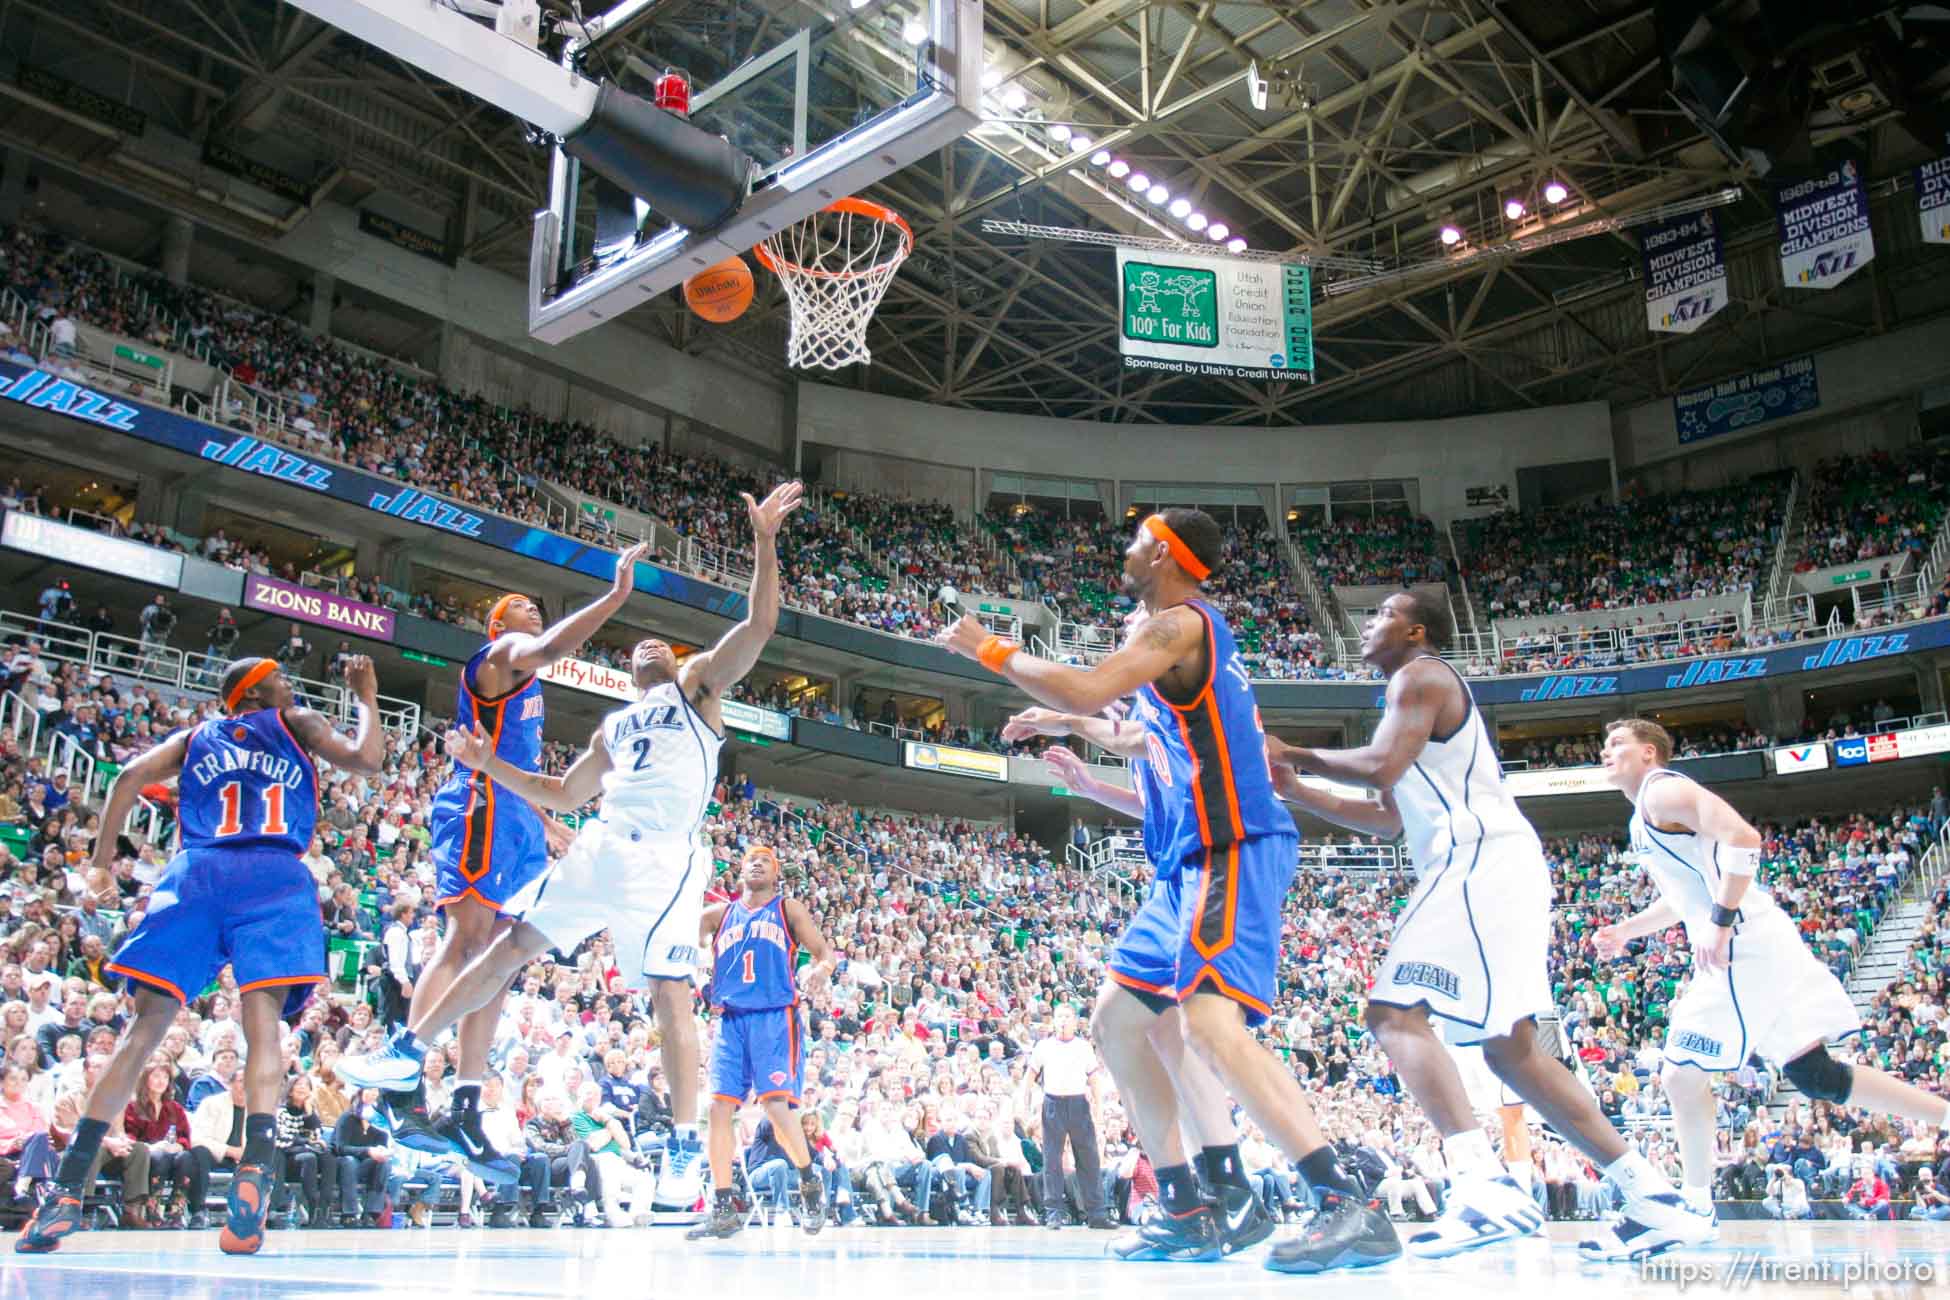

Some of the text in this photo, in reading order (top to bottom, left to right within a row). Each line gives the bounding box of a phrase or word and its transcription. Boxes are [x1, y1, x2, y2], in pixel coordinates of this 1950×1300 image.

[1784, 188, 1858, 225] MIDWEST
[1787, 204, 1859, 239] DIVISION
[1781, 216, 1869, 256] CHAMPIONS
[1650, 239, 1716, 271] MIDWEST
[1653, 252, 1717, 284] DIVISION
[1232, 286, 1270, 298] Credit
[1237, 271, 1264, 284] Utah
[1646, 264, 1726, 301] CHAMPIONS
[1228, 311, 1279, 327] Education
[1235, 301, 1267, 312] Union
[1162, 317, 1182, 339] For
[1185, 320, 1212, 342] Kids
[1226, 325, 1282, 339] Foundation
[1124, 356, 1308, 381] Sponsored by Utah's Credit Unions
[1677, 385, 1715, 408] Mascot
[201, 435, 334, 491] JAZZ
[369, 487, 484, 537] JAZZ
[255, 583, 388, 634] ZIONS BANK
[1802, 634, 1910, 670] JAZZ
[590, 664, 627, 693] lube
[1520, 675, 1618, 704] JAZZ
[1666, 658, 1767, 689] JAZZ
[611, 704, 684, 751] JAZZ
[192, 748, 303, 790] CRAWFORD
[632, 737, 653, 772] 2
[214, 780, 288, 837] 11
[718, 920, 787, 959] NEW YORK
[742, 949, 756, 984] 1
[1392, 961, 1461, 1001] UTAH
[1671, 1030, 1723, 1057] UTAH
